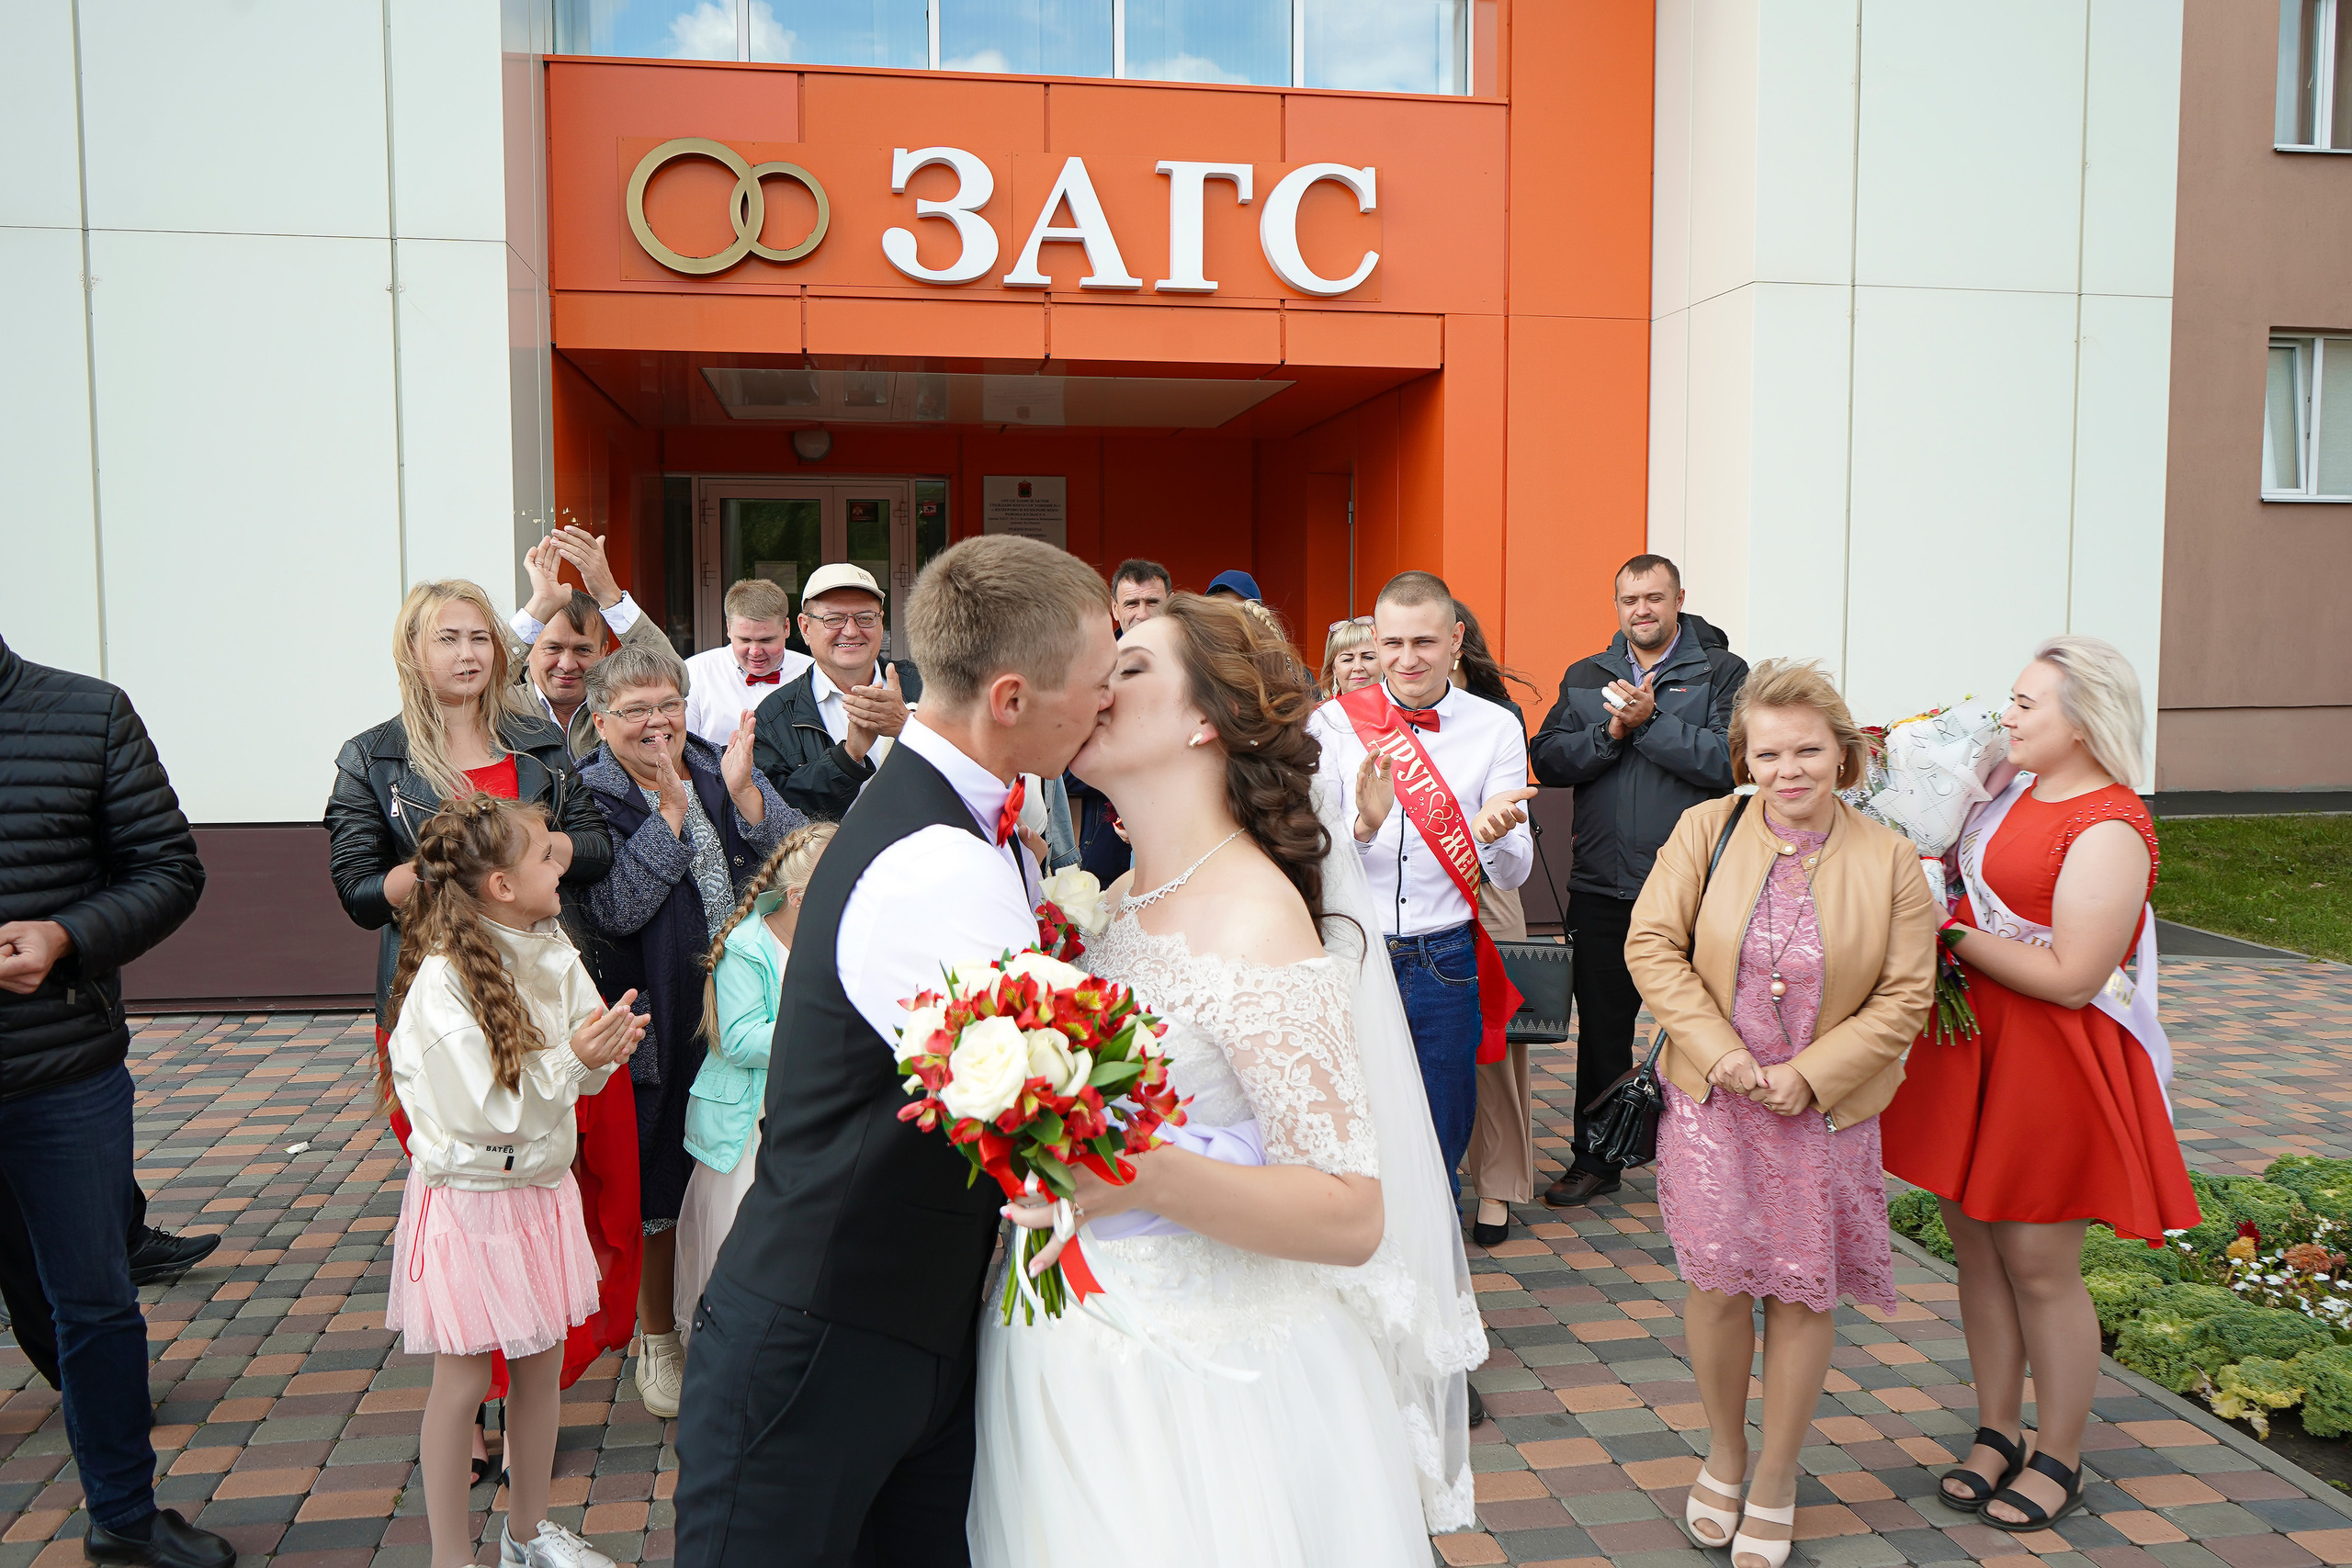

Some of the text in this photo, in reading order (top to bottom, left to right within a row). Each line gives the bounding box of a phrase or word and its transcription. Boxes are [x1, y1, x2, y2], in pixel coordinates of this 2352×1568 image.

[882, 147, 1380, 297] ЗАГС
[1367, 726, 1439, 795] ДРУГ
[486, 1145, 514, 1154] BATED
